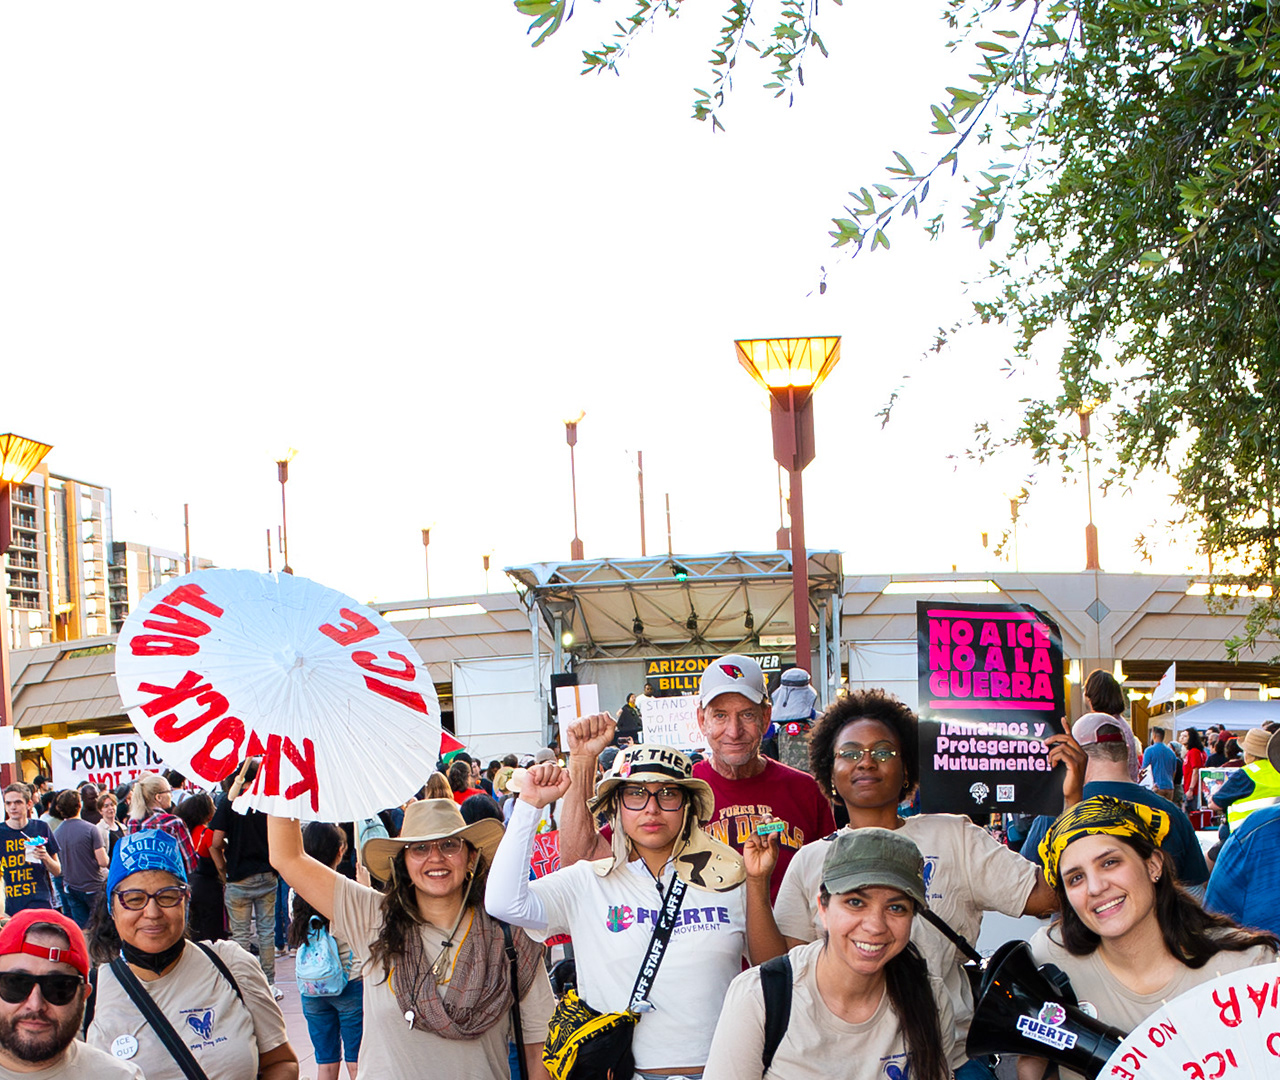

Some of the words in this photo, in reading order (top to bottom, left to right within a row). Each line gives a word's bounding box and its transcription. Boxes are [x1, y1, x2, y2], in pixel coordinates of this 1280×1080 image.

[929, 619, 974, 646] NO
[979, 622, 1002, 646] A
[1007, 622, 1051, 648] ICE
[318, 607, 429, 716] ICE
[648, 659, 721, 674] ARIZON
[751, 655, 780, 669] VER
[929, 645, 976, 671] NO
[984, 646, 1006, 671] A
[1015, 647, 1053, 674] LA
[929, 670, 1055, 700] GUERRA
[646, 698, 687, 711] STAND
[669, 711, 699, 722] FASCI
[648, 723, 678, 734] WHILE
[1034, 722, 1045, 737] y
[936, 736, 1049, 756] Protegernos
[70, 741, 138, 771] POWER
[648, 748, 684, 769] THE
[933, 753, 1053, 771] Mutuamente!
[719, 804, 755, 820] FORKS
[6, 836, 27, 852] RIS
[121, 838, 174, 862] ABOLISH
[11, 870, 34, 887] THE
[6, 881, 37, 898] REST
[673, 922, 721, 936] MOVEMENT
[646, 938, 664, 979] STAFF
[1019, 1018, 1075, 1046] FUERTE
[1147, 1017, 1178, 1048] NO
[116, 1037, 130, 1046] ICE
[117, 1047, 134, 1057] OUT
